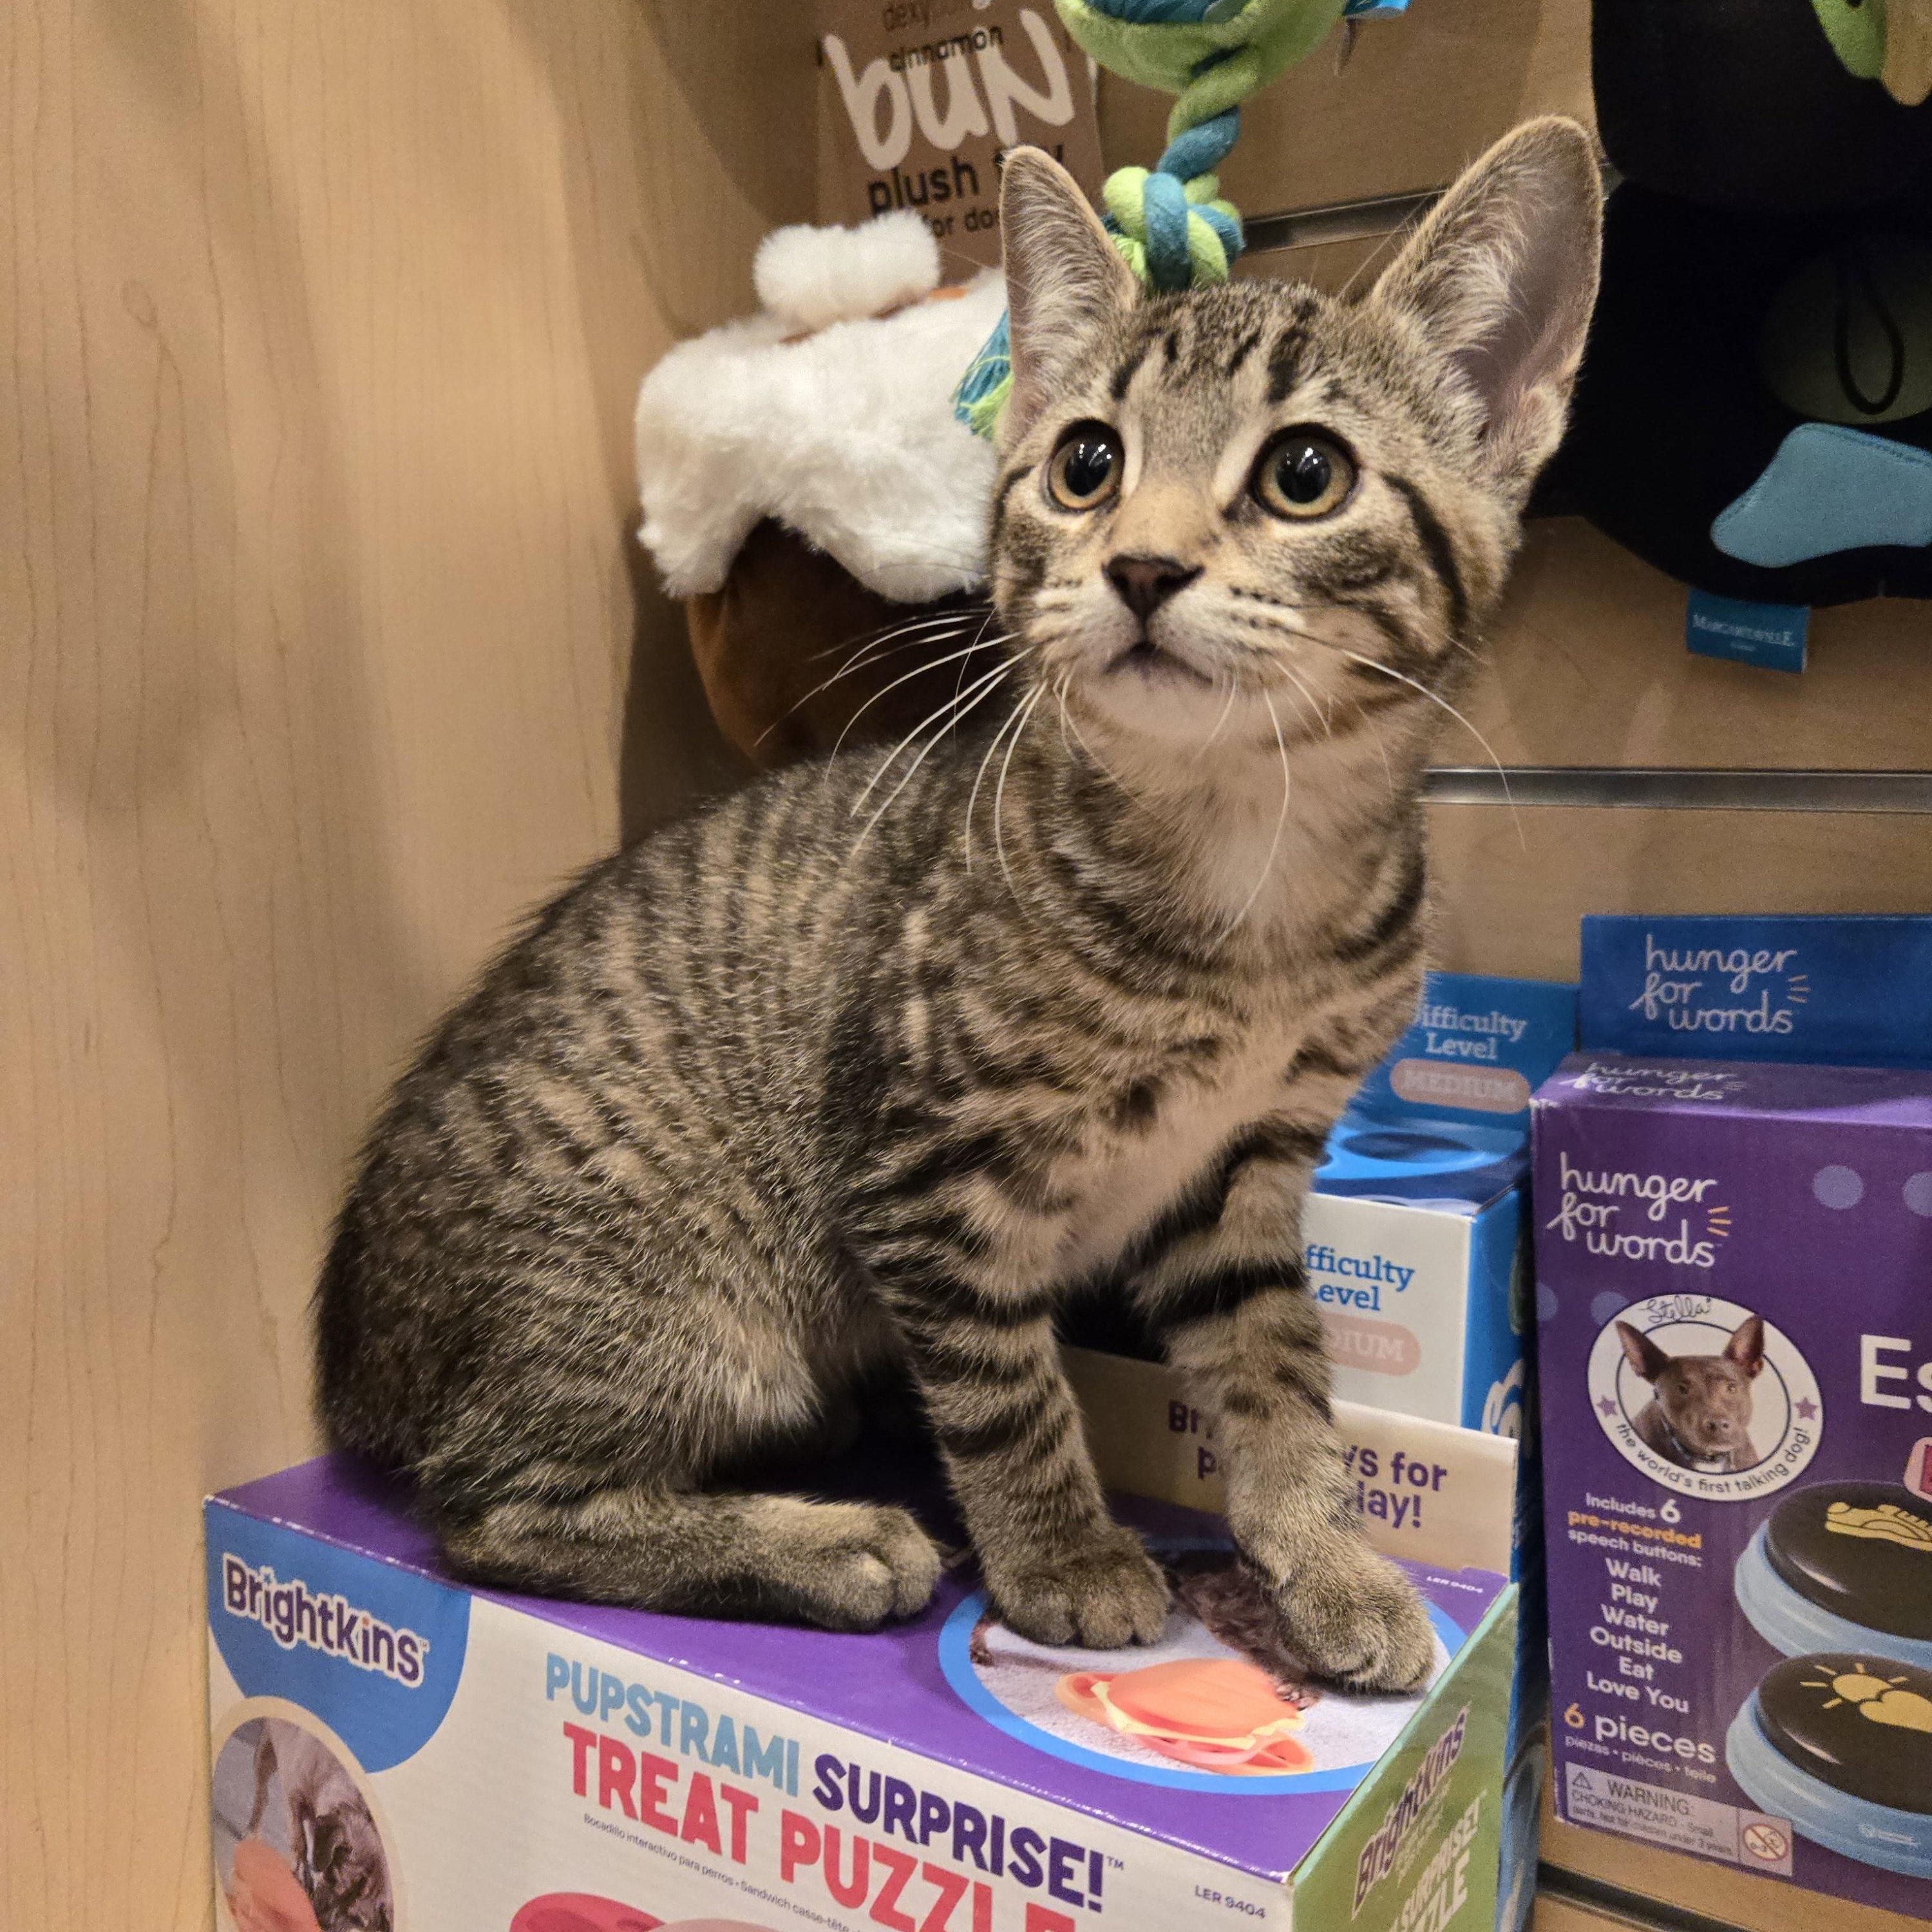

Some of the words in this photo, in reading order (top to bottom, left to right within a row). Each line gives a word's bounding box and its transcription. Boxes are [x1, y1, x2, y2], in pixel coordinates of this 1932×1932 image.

[889, 24, 1003, 73] cinnamon
[869, 155, 979, 218] plush
[1645, 934, 1797, 994] hunger
[1629, 973, 1703, 1020] for
[1668, 990, 1794, 1034] words
[1417, 1002, 1527, 1043] ifficulty
[1425, 1032, 1498, 1060] Level
[1586, 1063, 1738, 1086] hunger
[1595, 1082, 1725, 1100] words
[1560, 1151, 1717, 1222] hunger
[1547, 1191, 1620, 1242] for
[1586, 1218, 1716, 1267] words
[1306, 1244, 1416, 1292] fficulty
[1314, 1284, 1381, 1311] evel
[1343, 1328, 1405, 1362] IUM
[1391, 1451, 1447, 1491] for
[1616, 1423, 1636, 1448] the
[1637, 1450, 1692, 1488] world's
[1698, 1479, 1731, 1493] first
[1734, 1462, 1789, 1493] talking
[1784, 1426, 1812, 1463] dog!
[1586, 1492, 1656, 1520] Includes
[1660, 1498, 1681, 1524] 6
[1567, 1511, 1702, 1549] pre-recorded
[1567, 1529, 1629, 1551] speech
[1633, 1539, 1702, 1567] buttons:
[1605, 1557, 1662, 1588] Walk
[1611, 1583, 1658, 1614] Play
[225, 1557, 420, 1683] Brightkins
[1600, 1604, 1671, 1638] Water
[1589, 1625, 1683, 1665] Outside
[1619, 1656, 1654, 1681] Eat
[1586, 1670, 1640, 1702] Love
[1645, 1685, 1689, 1714] You
[1564, 1701, 1585, 1729] 6
[1595, 1714, 1716, 1765] pieces
[545, 1651, 800, 1797] PUPSTRAMI
[812, 1753, 1104, 1913] SURPRISE!
[563, 1720, 759, 1866] TREAT
[678, 1855, 701, 1872] para
[701, 1865, 734, 1887] perros
[739, 1880, 791, 1911] Sandwich
[1195, 1884, 1221, 1904] LER
[1224, 1896, 1266, 1920] 9404
